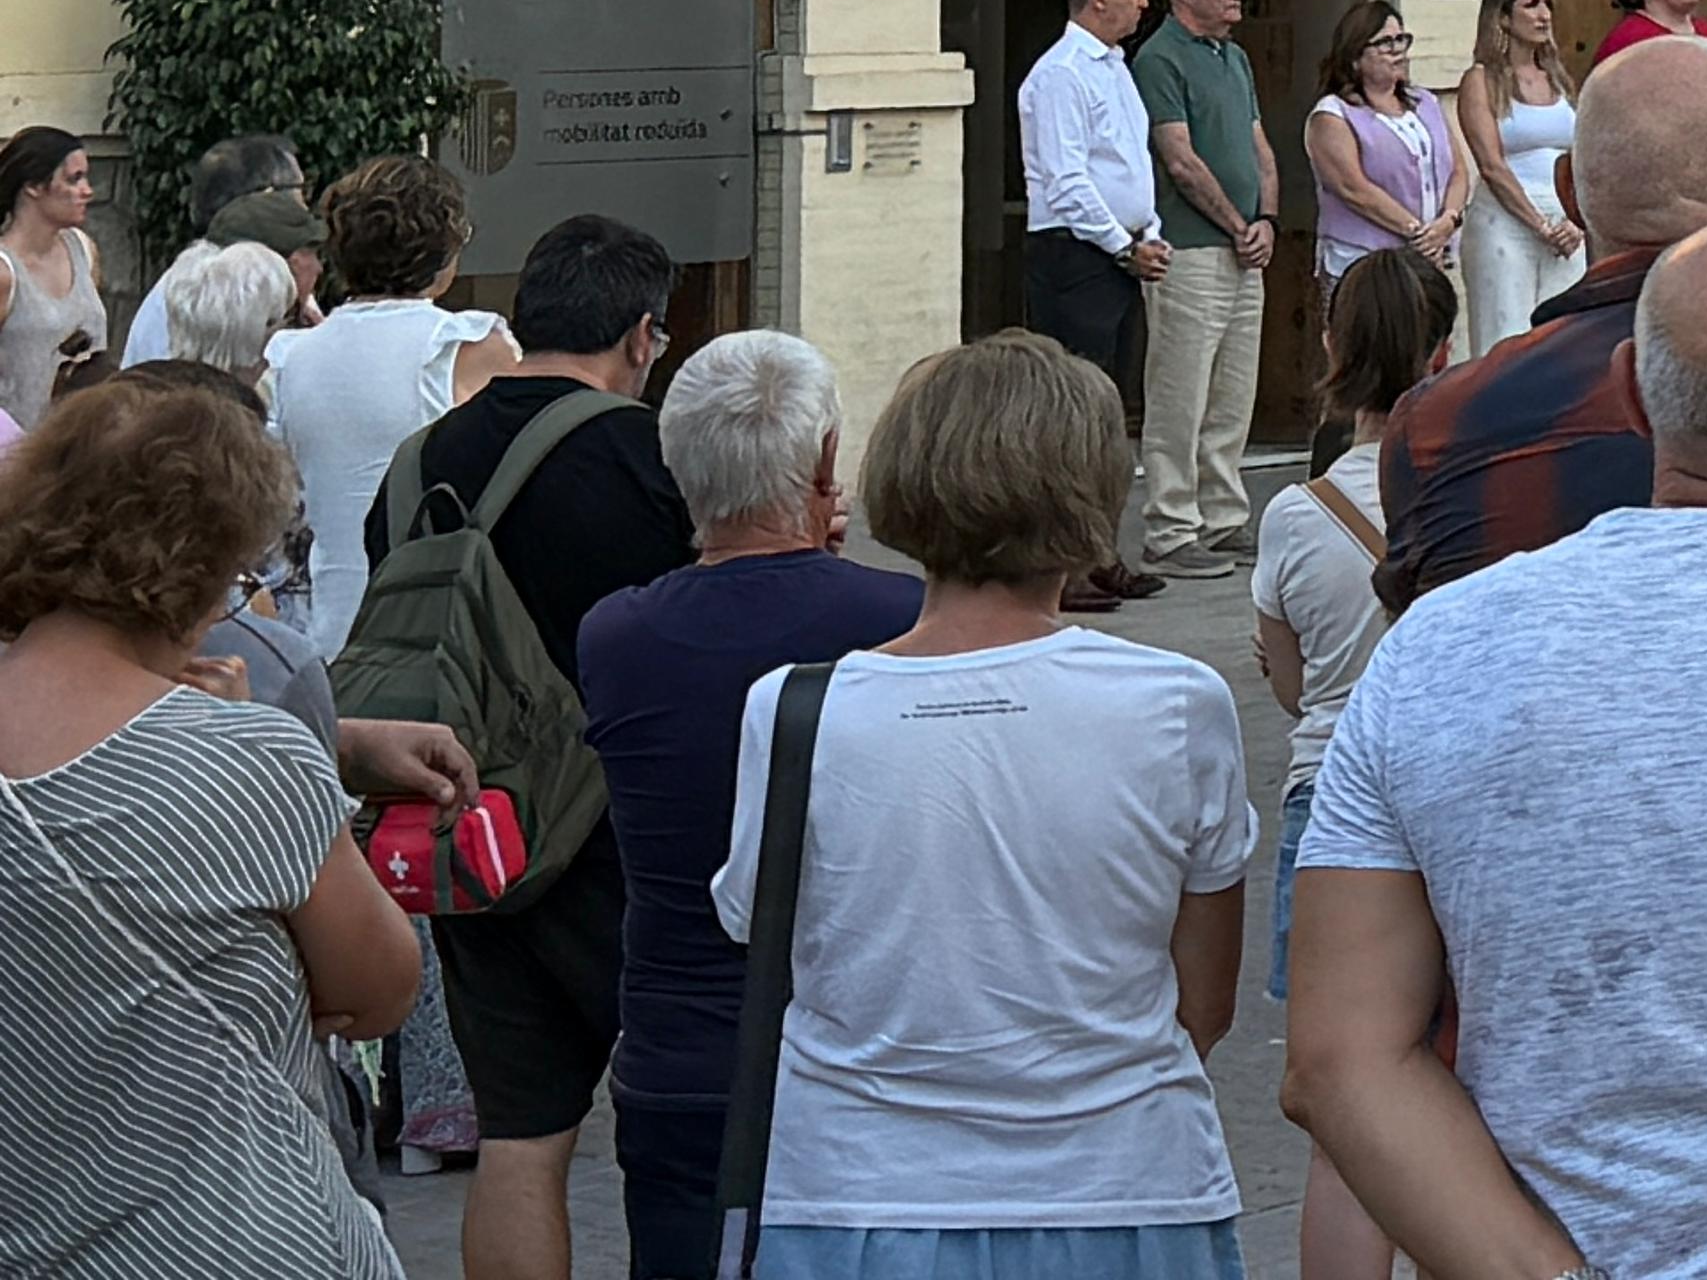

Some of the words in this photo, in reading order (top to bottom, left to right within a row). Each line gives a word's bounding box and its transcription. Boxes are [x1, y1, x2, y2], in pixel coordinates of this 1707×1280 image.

[542, 88, 634, 111] Persones
[638, 86, 681, 107] amb
[543, 120, 631, 145] mobilitat
[634, 118, 708, 141] reduïda
